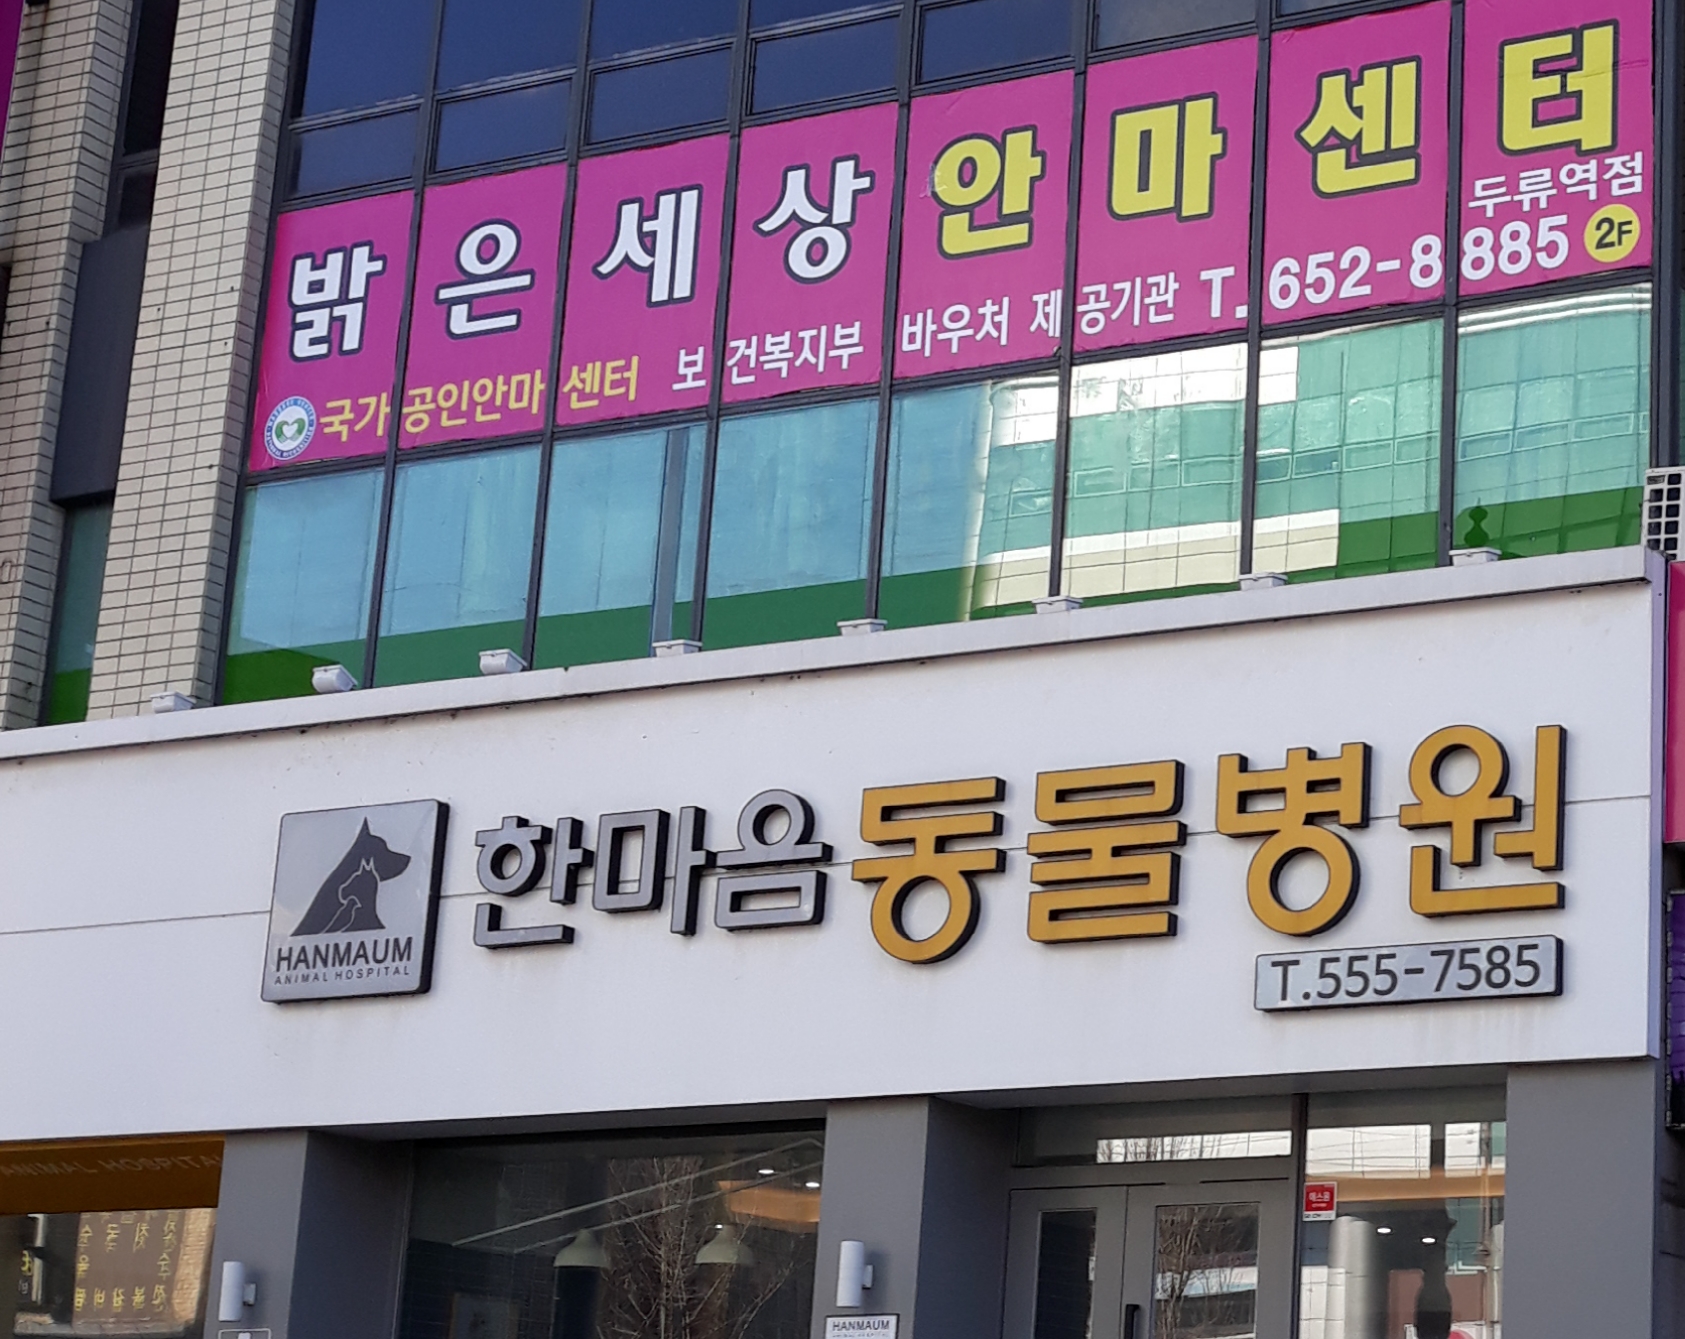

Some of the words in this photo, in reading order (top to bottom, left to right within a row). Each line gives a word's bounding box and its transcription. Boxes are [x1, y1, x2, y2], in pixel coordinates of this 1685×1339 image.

[288, 154, 876, 361] 밝은세상
[931, 19, 1620, 260] 안마센터
[1468, 151, 1643, 218] 두류역점
[901, 296, 1010, 357] 바우처
[1595, 217, 1633, 250] 2F
[472, 788, 832, 949] 한마음
[851, 723, 1566, 966] 동물병원
[274, 972, 328, 985] ANIMAL
[334, 966, 410, 980] HOSPITAL
[276, 937, 413, 972] HANMAUM
[1269, 943, 1541, 1004] T.555-7585
[832, 1319, 889, 1331] HANMAUM
